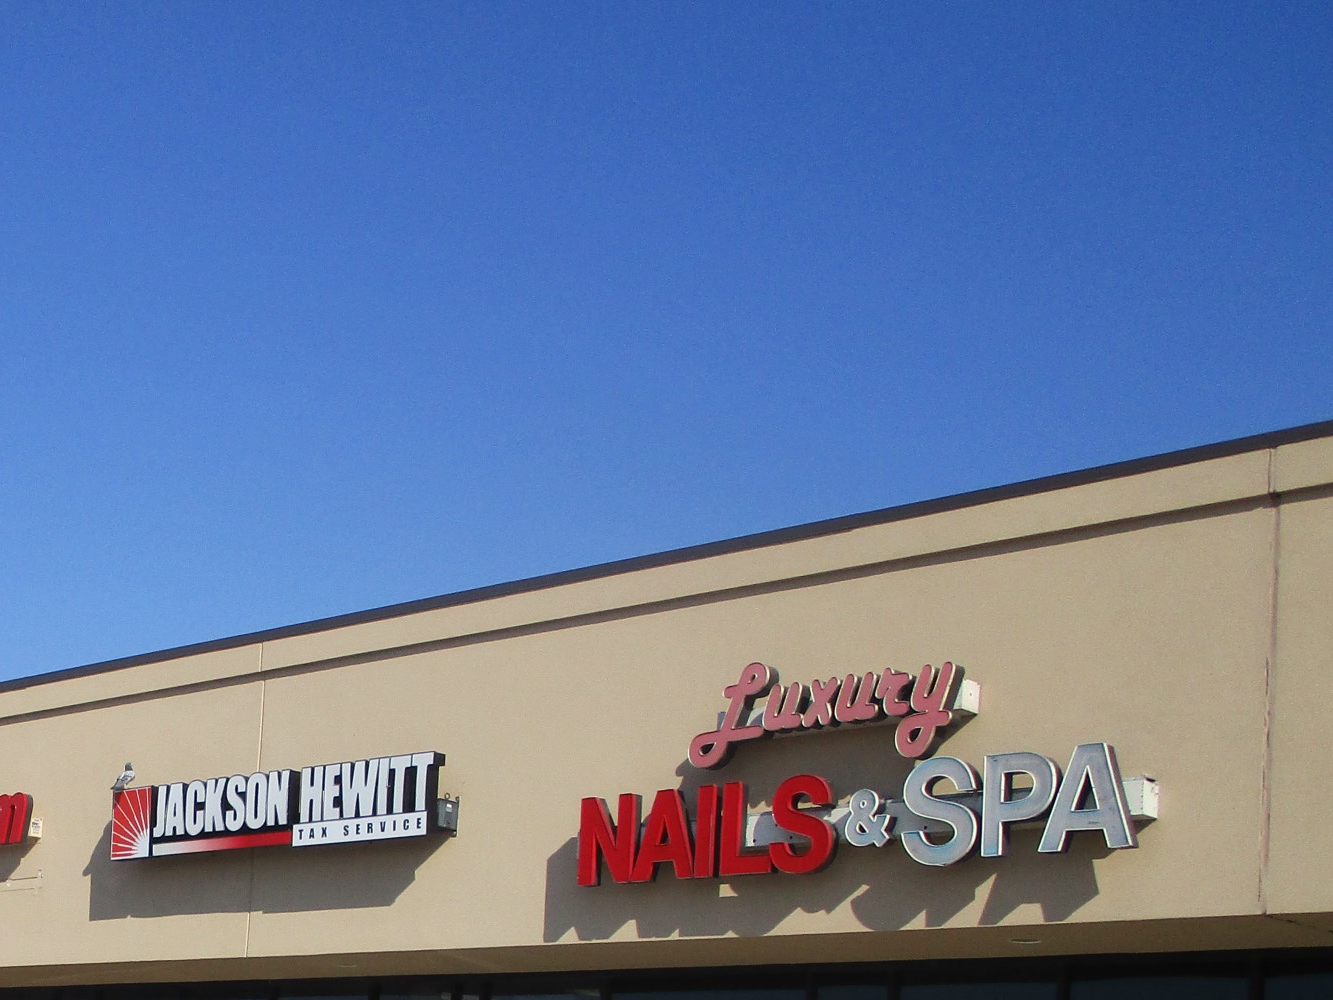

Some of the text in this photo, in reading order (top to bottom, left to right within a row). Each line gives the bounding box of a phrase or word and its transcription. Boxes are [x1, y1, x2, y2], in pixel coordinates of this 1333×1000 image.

[688, 661, 963, 769] Luxury
[153, 752, 435, 838] JACKSON HEWITT
[297, 817, 423, 841] TAX SERVICE
[577, 742, 1138, 887] NAILS & SPA
